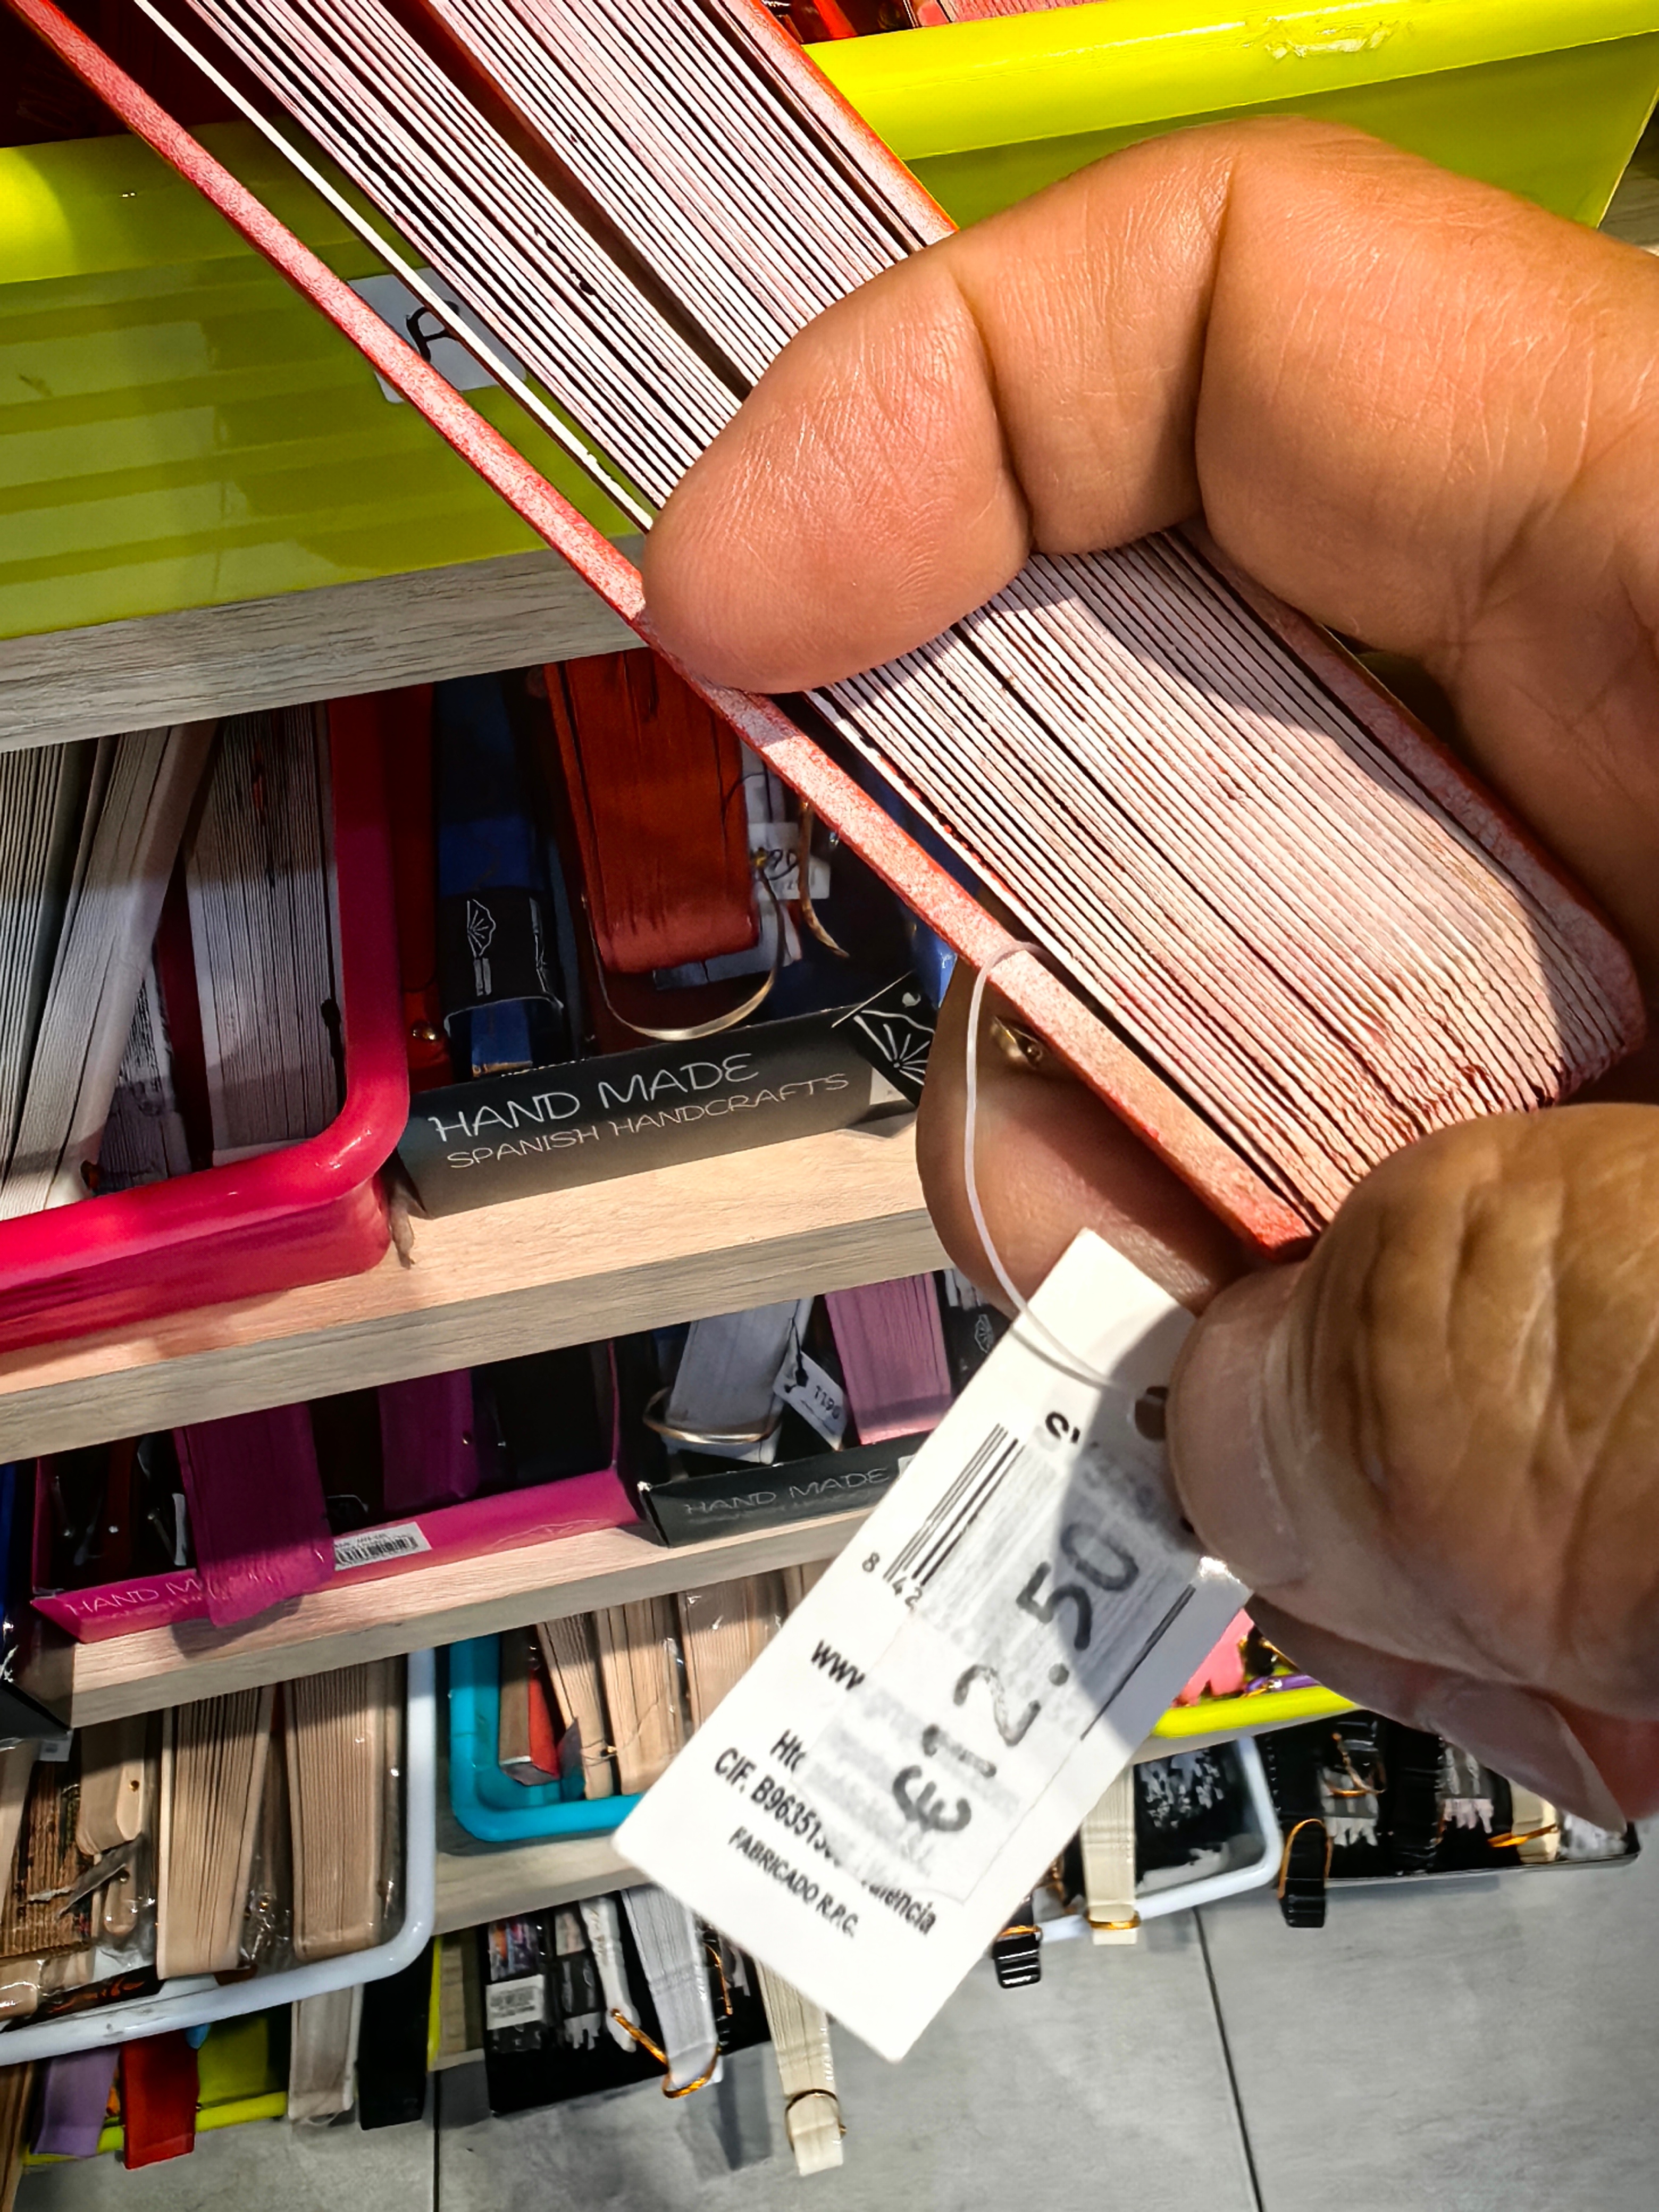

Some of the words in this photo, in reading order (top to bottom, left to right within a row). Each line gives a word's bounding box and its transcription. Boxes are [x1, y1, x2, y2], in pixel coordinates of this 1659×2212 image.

[428, 1092, 581, 1143] HAND
[598, 1053, 759, 1109] MADE
[447, 1126, 600, 1168] SPANISH
[609, 1073, 849, 1136] HANDCRAFTS
[684, 1492, 777, 1515] HAND
[789, 1468, 890, 1499] MADE
[65, 1588, 160, 1616] HAND
[714, 1747, 757, 1794] CIF.
[727, 1826, 819, 1906] FABRICADO
